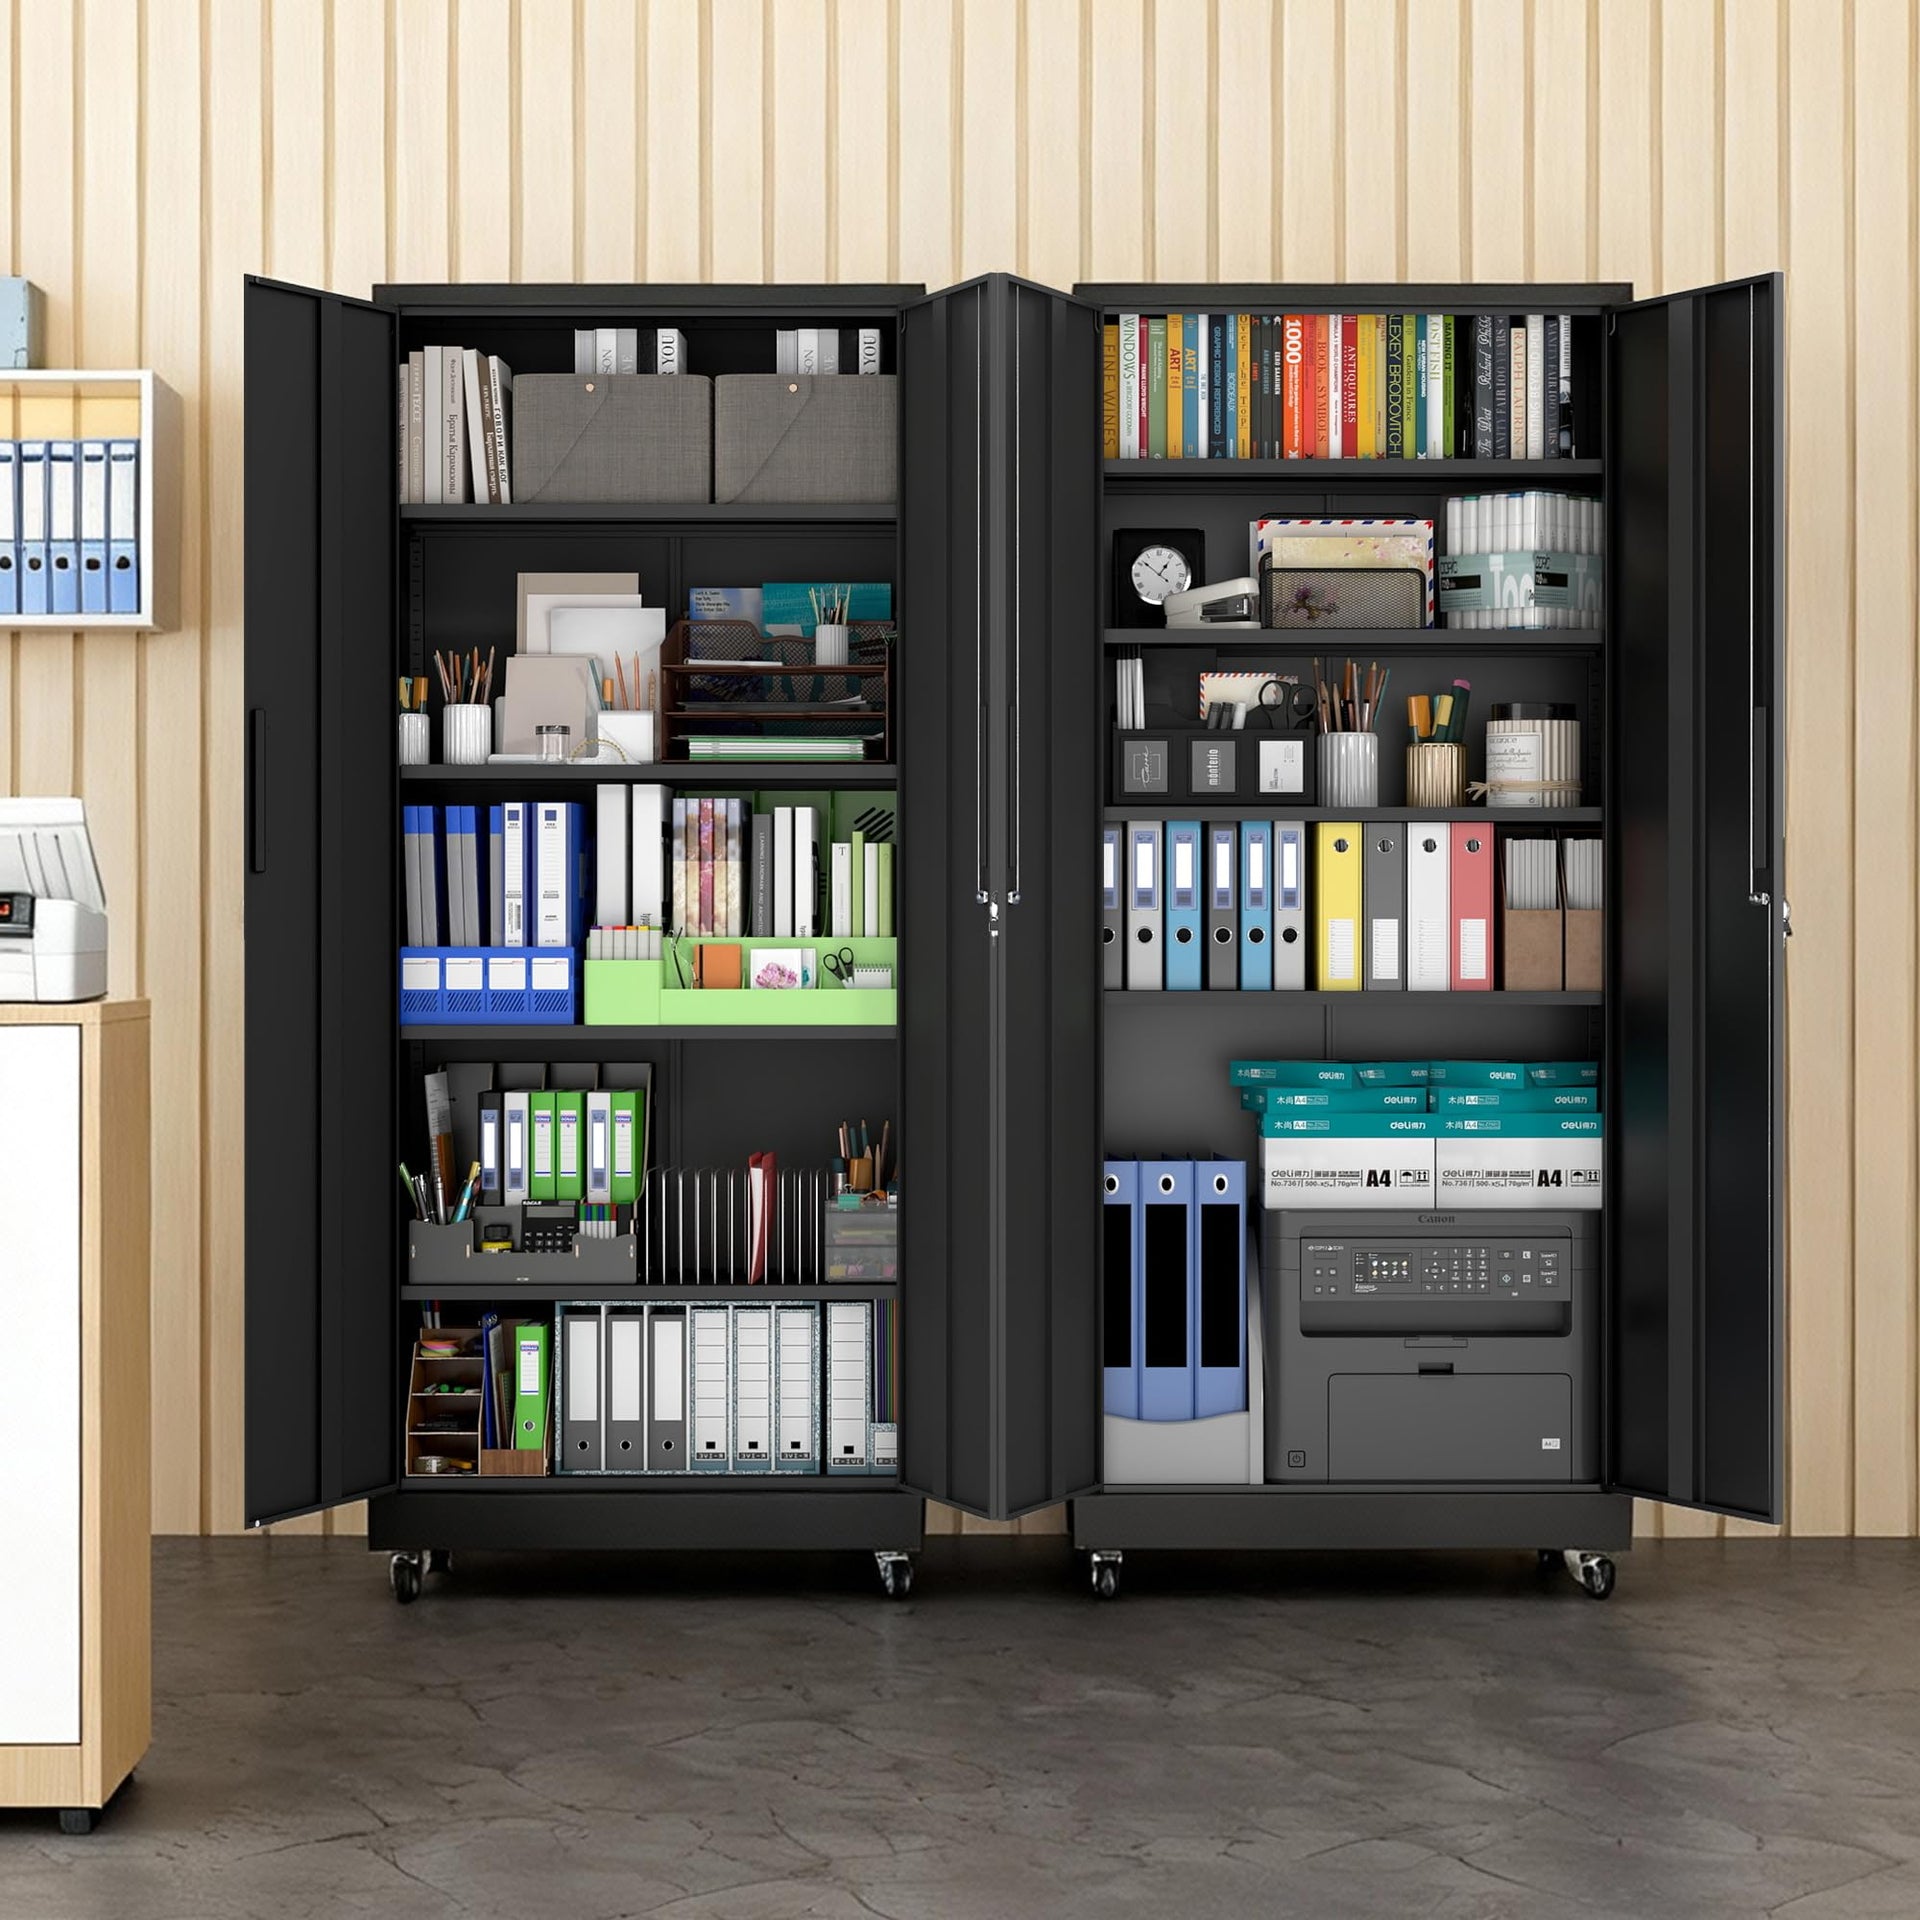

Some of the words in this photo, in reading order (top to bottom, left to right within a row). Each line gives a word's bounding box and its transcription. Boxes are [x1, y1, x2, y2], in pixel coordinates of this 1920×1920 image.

[1286, 319, 1302, 363] 1000
[1430, 315, 1440, 347] LOST
[1444, 322, 1452, 360] MAKING
[1496, 328, 1506, 363] YEARS
[1548, 322, 1558, 360] VANITY
[661, 335, 675, 365] YOU
[863, 336, 876, 365] YOU
[1104, 344, 1116, 382] FINE
[1123, 318, 1136, 380] WINDOWS
[1169, 348, 1181, 372] ART
[1184, 348, 1196, 372] ART
[1317, 342, 1327, 373] BOOK
[1513, 331, 1523, 381] RALPH
[1405, 355, 1413, 385] Gardens
[1430, 351, 1440, 380] FISH
[1444, 362, 1452, 371] IT
[1496, 367, 1506, 386] 100
[1530, 354, 1541, 398] BEYOND
[1548, 364, 1558, 388] FAIR
[1346, 345, 1356, 423] ANTIQUAIRES
[412, 394, 421, 423] ГЕССЕ
[1104, 389, 1116, 446] WINES
[1317, 385, 1327, 442] SYMBOLS
[1389, 364, 1401, 453] BRODOVITCH
[1496, 389, 1506, 414] FAIR
[1513, 386, 1523, 445] LAUREN
[447, 414, 458, 442] Братья
[494, 408, 504, 447] ГОВОРИ
[1496, 418, 1506, 458] VANITY
[1530, 402, 1541, 456] PAINTING
[1548, 413, 1558, 445] YEARS
[486, 431, 496, 470] Бархатная
[1477, 438, 1492, 457] The
[446, 444, 458, 495] Карамазовы
[838, 847, 846, 856] T
[1366, 1170, 1391, 1187] A4
[1536, 1170, 1561, 1187] A4
[1418, 1215, 1455, 1223] Canon
